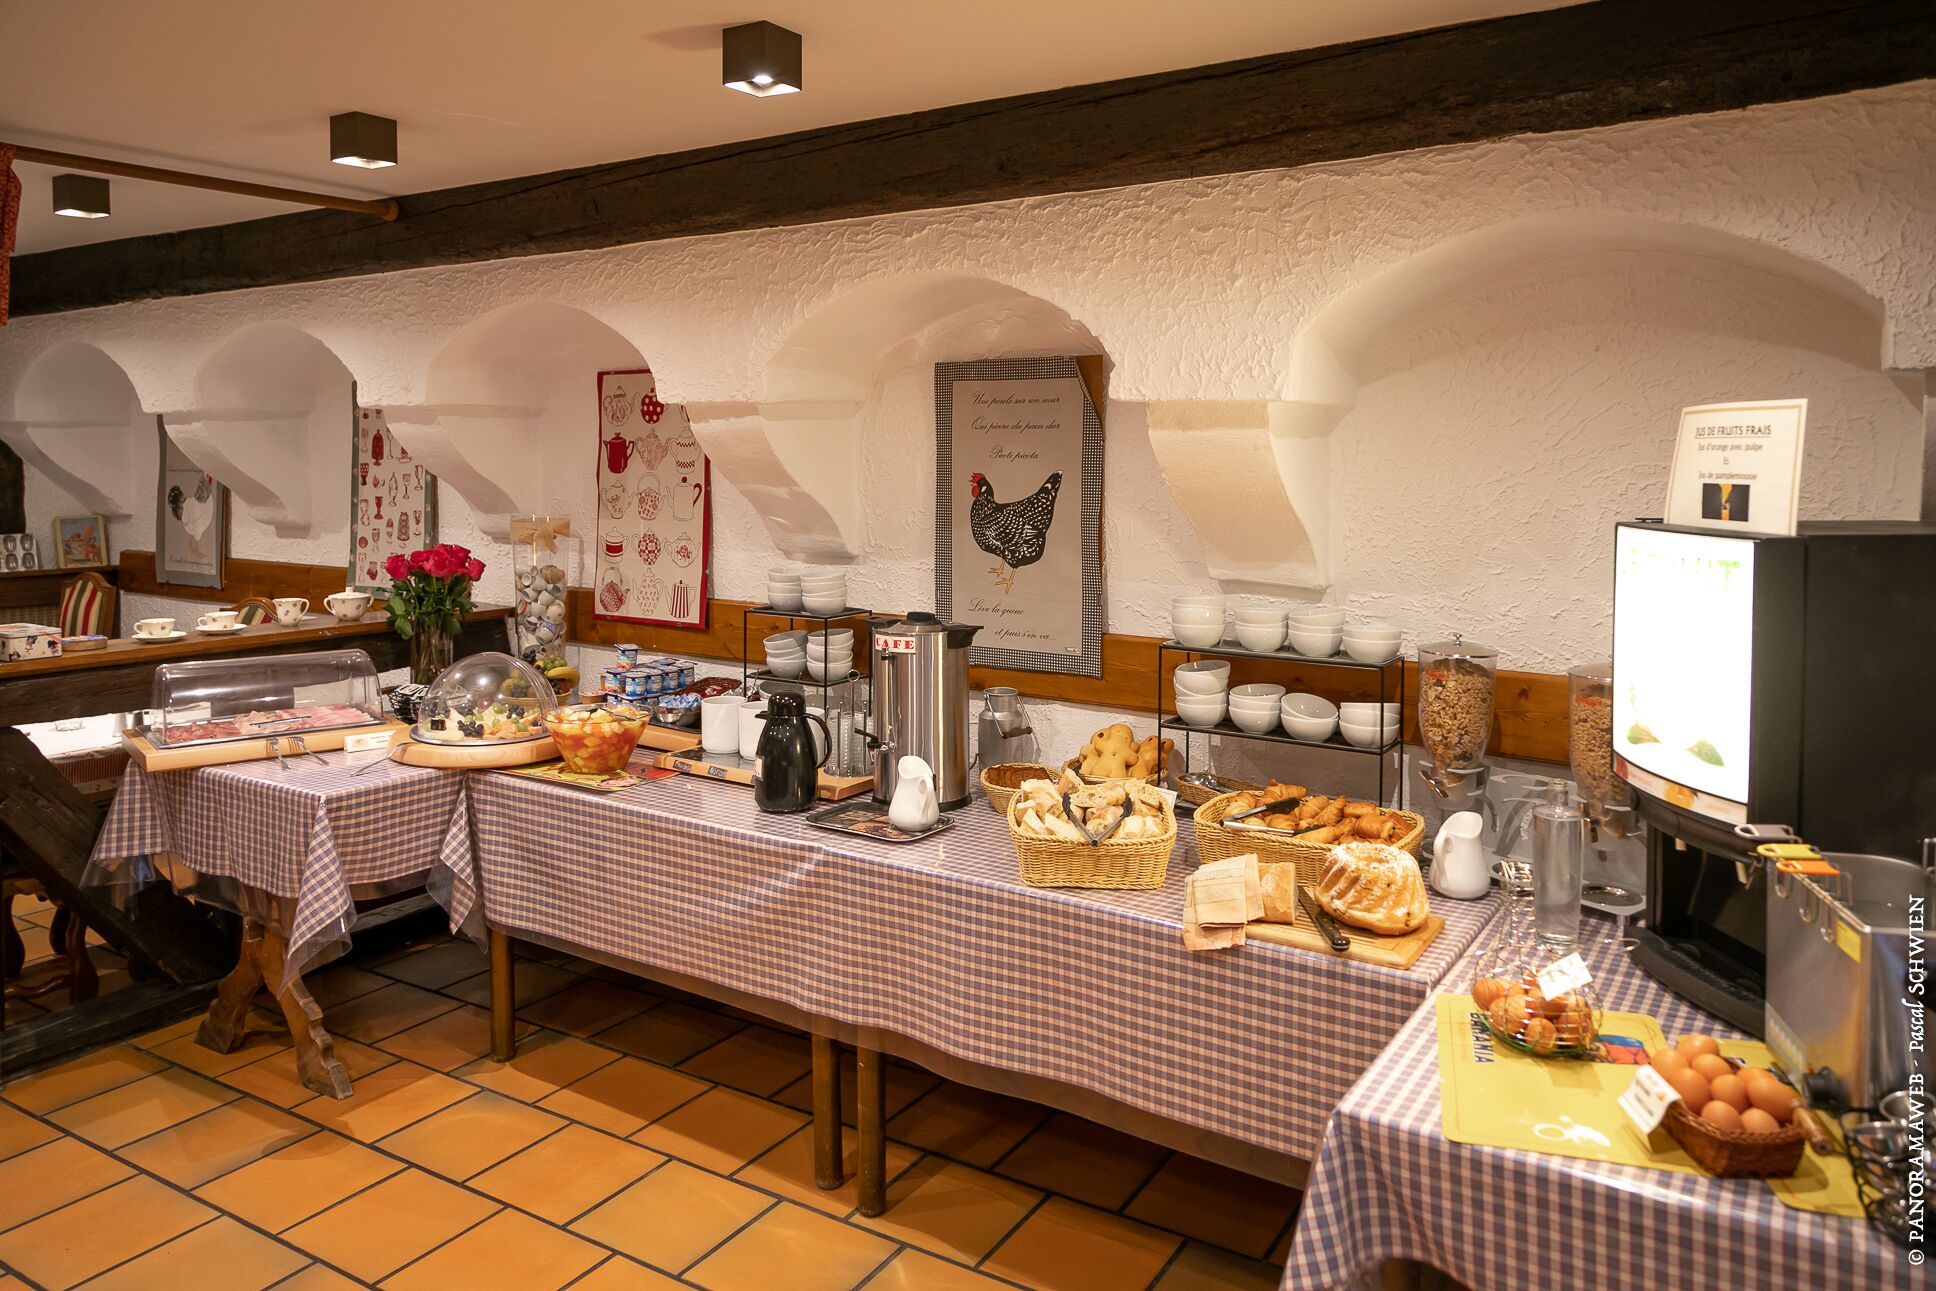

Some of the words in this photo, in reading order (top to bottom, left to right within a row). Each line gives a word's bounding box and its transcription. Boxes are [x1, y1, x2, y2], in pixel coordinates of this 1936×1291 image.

[973, 391, 988, 405] Une
[987, 393, 1015, 408] poule
[971, 416, 987, 430] Qui
[1011, 420, 1021, 430] du
[1020, 423, 1044, 434] pain
[1046, 420, 1060, 430] dur
[1695, 427, 1706, 439] JUS
[1708, 426, 1716, 436] DE
[1718, 425, 1744, 436] FRUITS
[1746, 425, 1772, 436] FRAIS
[1745, 443, 1764, 452] pulpe
[992, 602, 1000, 613] la
[1000, 608, 1024, 617] queue
[994, 629, 1004, 637] et
[1000, 630, 1021, 640] puis
[1022, 631, 1037, 639] s'en
[875, 637, 915, 650] CAFE
